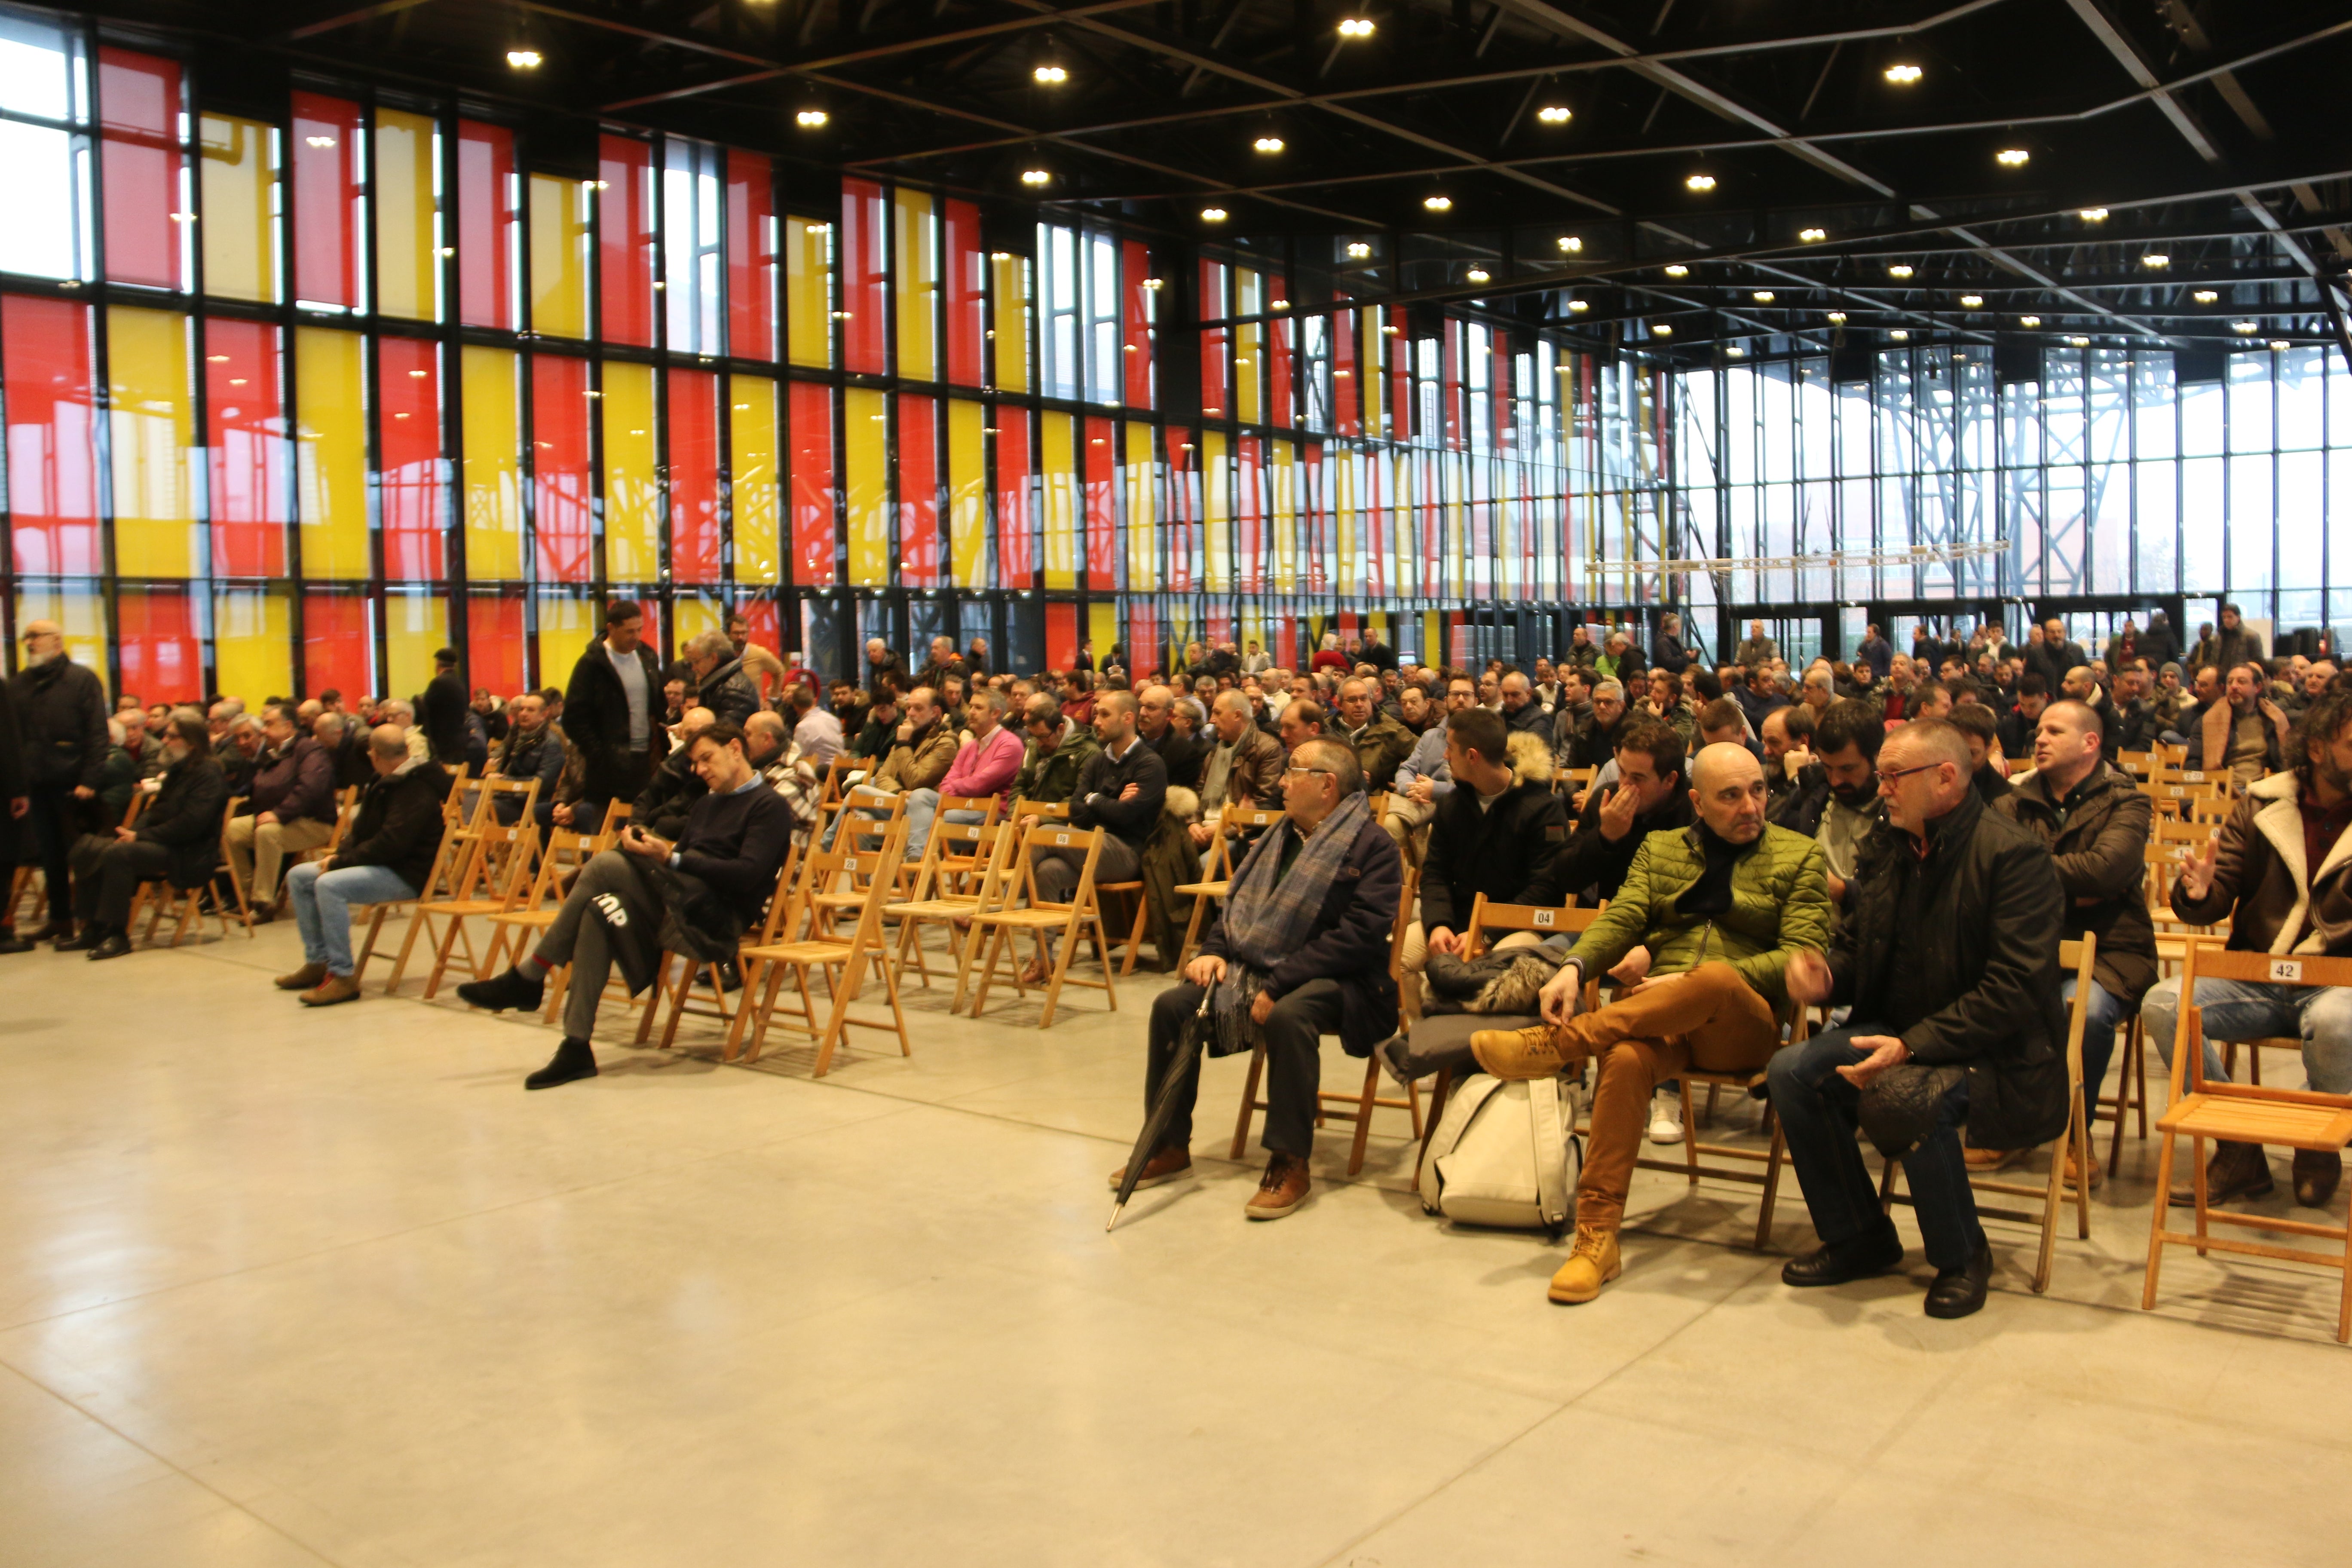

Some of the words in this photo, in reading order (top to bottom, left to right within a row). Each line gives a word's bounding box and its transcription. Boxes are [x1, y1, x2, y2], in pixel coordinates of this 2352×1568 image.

[1058, 835, 1066, 843] 08
[1538, 913, 1550, 923] 04
[2276, 964, 2294, 977] 42
